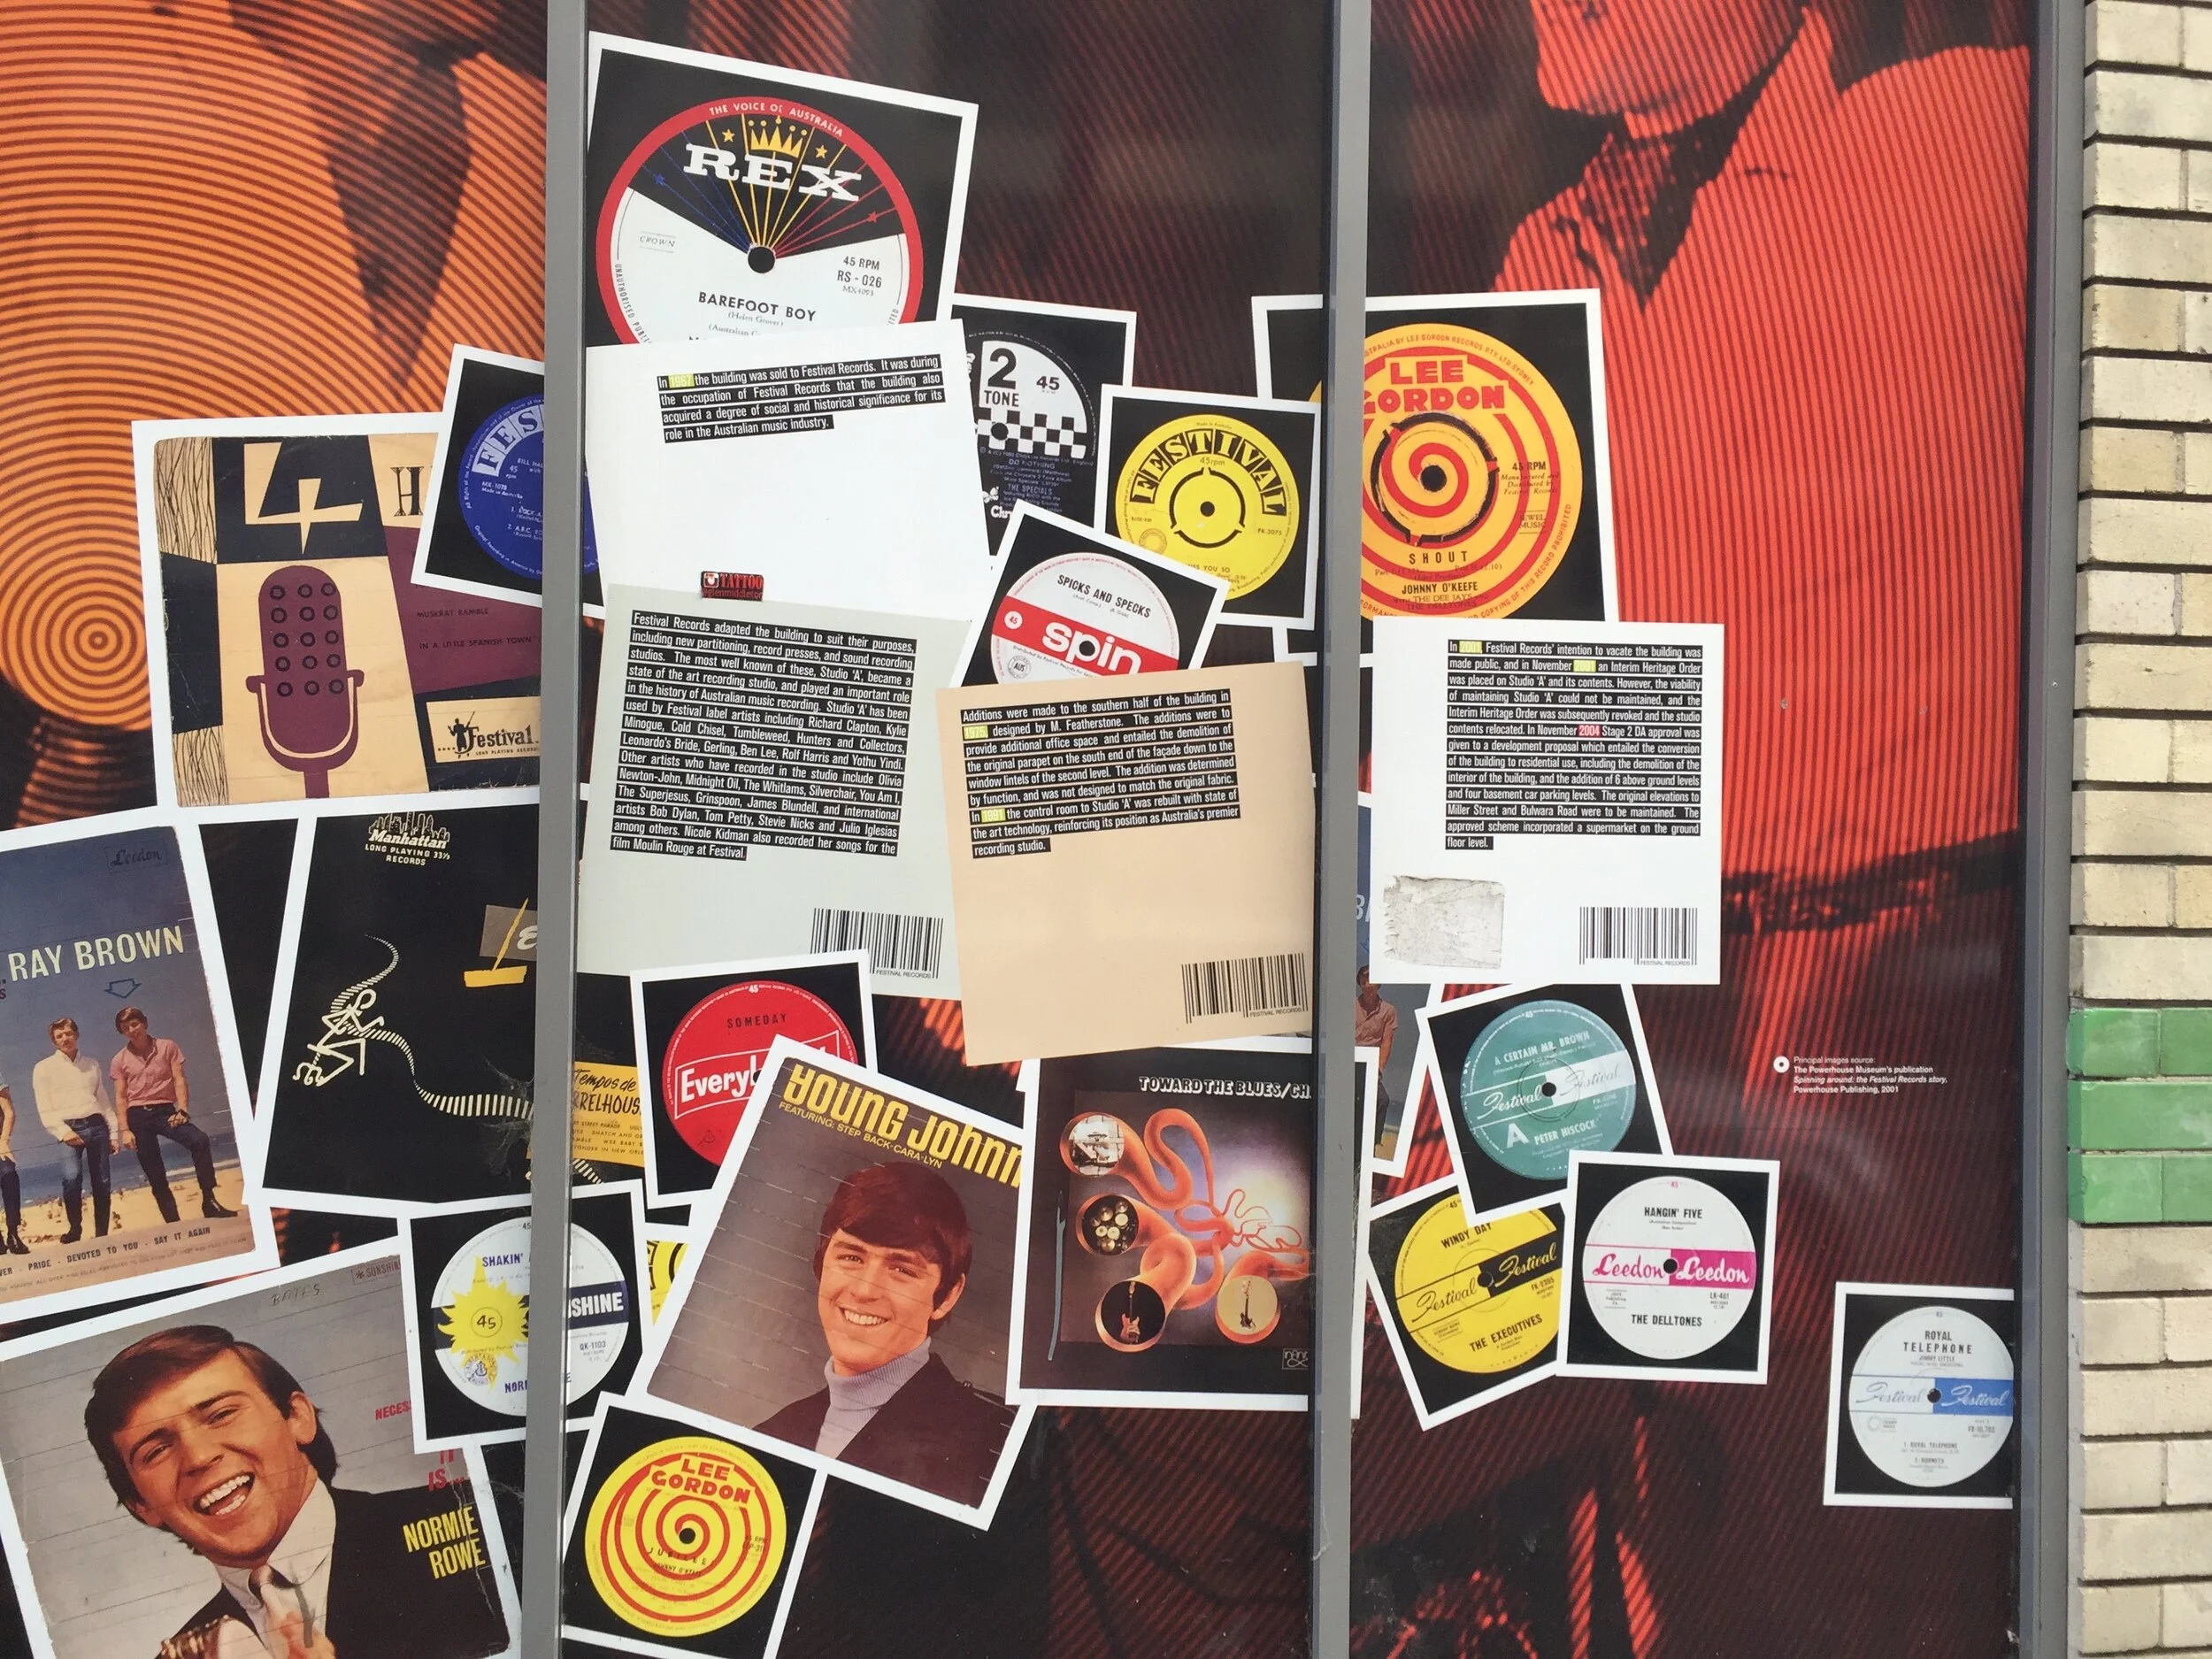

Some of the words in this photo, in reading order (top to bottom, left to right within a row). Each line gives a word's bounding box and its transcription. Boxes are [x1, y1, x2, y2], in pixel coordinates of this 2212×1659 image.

[709, 104, 728, 116] THE
[733, 102, 765, 111] VOICE
[788, 107, 843, 137] AUSTRALIA
[683, 142, 862, 203] REX
[639, 236, 676, 248] CROWN
[843, 257, 856, 268] 45
[858, 259, 880, 271] RPM
[698, 291, 779, 316] BAREFOOT
[785, 306, 816, 322] BOY
[658, 377, 668, 388] In
[694, 373, 710, 386] the
[710, 371, 747, 384] building
[749, 371, 767, 381] was
[769, 367, 787, 380] sold
[789, 367, 800, 378] to
[801, 363, 836, 377] Festival
[880, 359, 888, 371] It
[889, 359, 909, 370] was
[910, 356, 939, 369] during
[987, 348, 1017, 389] 2
[1390, 360, 1463, 385] LEE
[1036, 376, 1060, 390] 45
[984, 390, 1019, 407] TONE
[1130, 428, 1287, 516] FESTIVAL
[1528, 461, 1547, 471] RPM
[1409, 550, 1468, 565] SHOUT
[720, 573, 763, 590] TATTOO
[1402, 583, 1438, 595] JOHNNY
[1442, 581, 1478, 593] O'KEEFE
[1056, 574, 1091, 595] SPICKS
[1093, 588, 1112, 603] AND
[1115, 596, 1151, 618] SPECKS
[1041, 621, 1142, 674] spin
[615, 803, 646, 816] artists
[649, 804, 668, 818] Bob
[705, 810, 723, 822] Tom
[757, 814, 786, 827] Stevie
[789, 817, 815, 830] Nicks
[818, 820, 835, 832] and
[839, 821, 861, 834] Julio
[864, 823, 897, 837] Iglesias
[1447, 821, 1485, 833] approved
[1487, 821, 1519, 832] scheme
[1523, 821, 1573, 834] incorporated
[1577, 824, 1583, 834] a
[1586, 823, 1637, 835] supermarket
[1640, 825, 1650, 835] on
[1654, 823, 1668, 835] the
[1671, 824, 1699, 836] ground
[368, 828, 448, 849] Manhattan
[974, 843, 1015, 856] recording
[110, 848, 162, 866] Leedon
[365, 843, 387, 853] LONG
[390, 847, 430, 857] PLAYING
[386, 855, 426, 866] RECORDS
[8, 944, 62, 982] RAY
[74, 925, 184, 971] BROWN
[749, 984, 760, 994] 45
[726, 1013, 787, 1029] SOMEDAY
[1249, 1009, 1274, 1018] FESTIVAL
[1503, 1047, 1539, 1064] CERTAIN
[1559, 1031, 1591, 1048] BROWN
[1824, 1056, 1849, 1065] images
[1139, 1076, 1203, 1094] TOWARD
[1204, 1079, 1233, 1095] THE
[1793, 1076, 1825, 1085] Spinning
[1477, 1087, 1544, 1121] Festival
[1559, 1064, 1622, 1097] Festival
[779, 1102, 835, 1129] FEATURING:
[836, 1123, 862, 1138] STEP
[1506, 1122, 1529, 1148] A
[1534, 1132, 1559, 1146] PETER
[1561, 1120, 1597, 1139] HISCOCK
[1644, 1206, 1680, 1218] HANGIN'
[1684, 1209, 1703, 1219] FIVE
[1440, 1230, 1471, 1249] WINDY
[1474, 1222, 1492, 1236] DAY
[28, 1259, 51, 1271] PRIDE
[66, 1249, 101, 1263] DEVOTED
[106, 1246, 117, 1255] TO
[122, 1241, 138, 1251] YOU
[153, 1235, 169, 1245] SAY
[173, 1232, 181, 1240] IT
[188, 1226, 211, 1239] AGAIN
[482, 1253, 524, 1268] SHAKIN'
[1593, 1253, 1665, 1279] Leedon
[1676, 1256, 1750, 1284] Leedon
[1411, 1278, 1478, 1323] Festival
[1494, 1241, 1557, 1288] Festival
[569, 1291, 624, 1318] SHINE
[476, 1315, 496, 1329] 45
[1632, 1314, 1648, 1325] THE
[1652, 1314, 1702, 1327] DELLTONES
[1469, 1337, 1487, 1353] THE
[1491, 1313, 1543, 1343] EXECUTIVES
[1924, 1330, 1953, 1341] ROYAL
[1903, 1341, 1973, 1355] TELEPHONE
[1855, 1381, 1925, 1404] Festival
[1940, 1384, 2010, 1407] Festival
[681, 1458, 731, 1481] LEE
[651, 1471, 751, 1504] GORDON
[403, 1506, 479, 1553] NORMIE
[429, 1539, 486, 1579] ROWE
